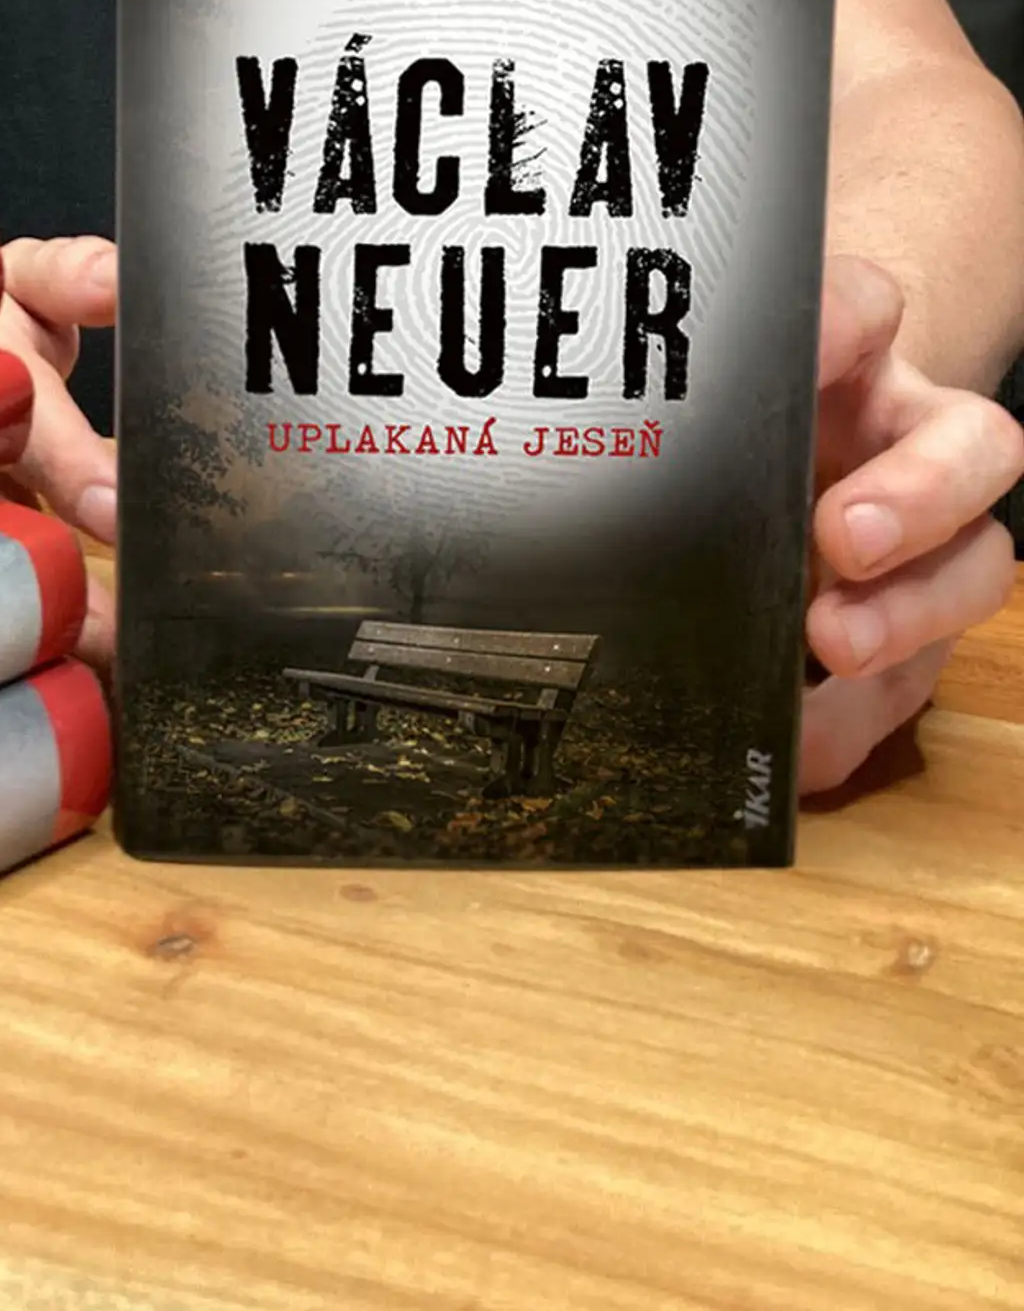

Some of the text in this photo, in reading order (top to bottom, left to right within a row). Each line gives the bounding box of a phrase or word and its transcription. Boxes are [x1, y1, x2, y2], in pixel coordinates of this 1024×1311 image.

[235, 32, 710, 219] VÁCLAV
[243, 241, 693, 401] NEUER
[267, 417, 665, 457] UPLAKANÁ JESEŇ
